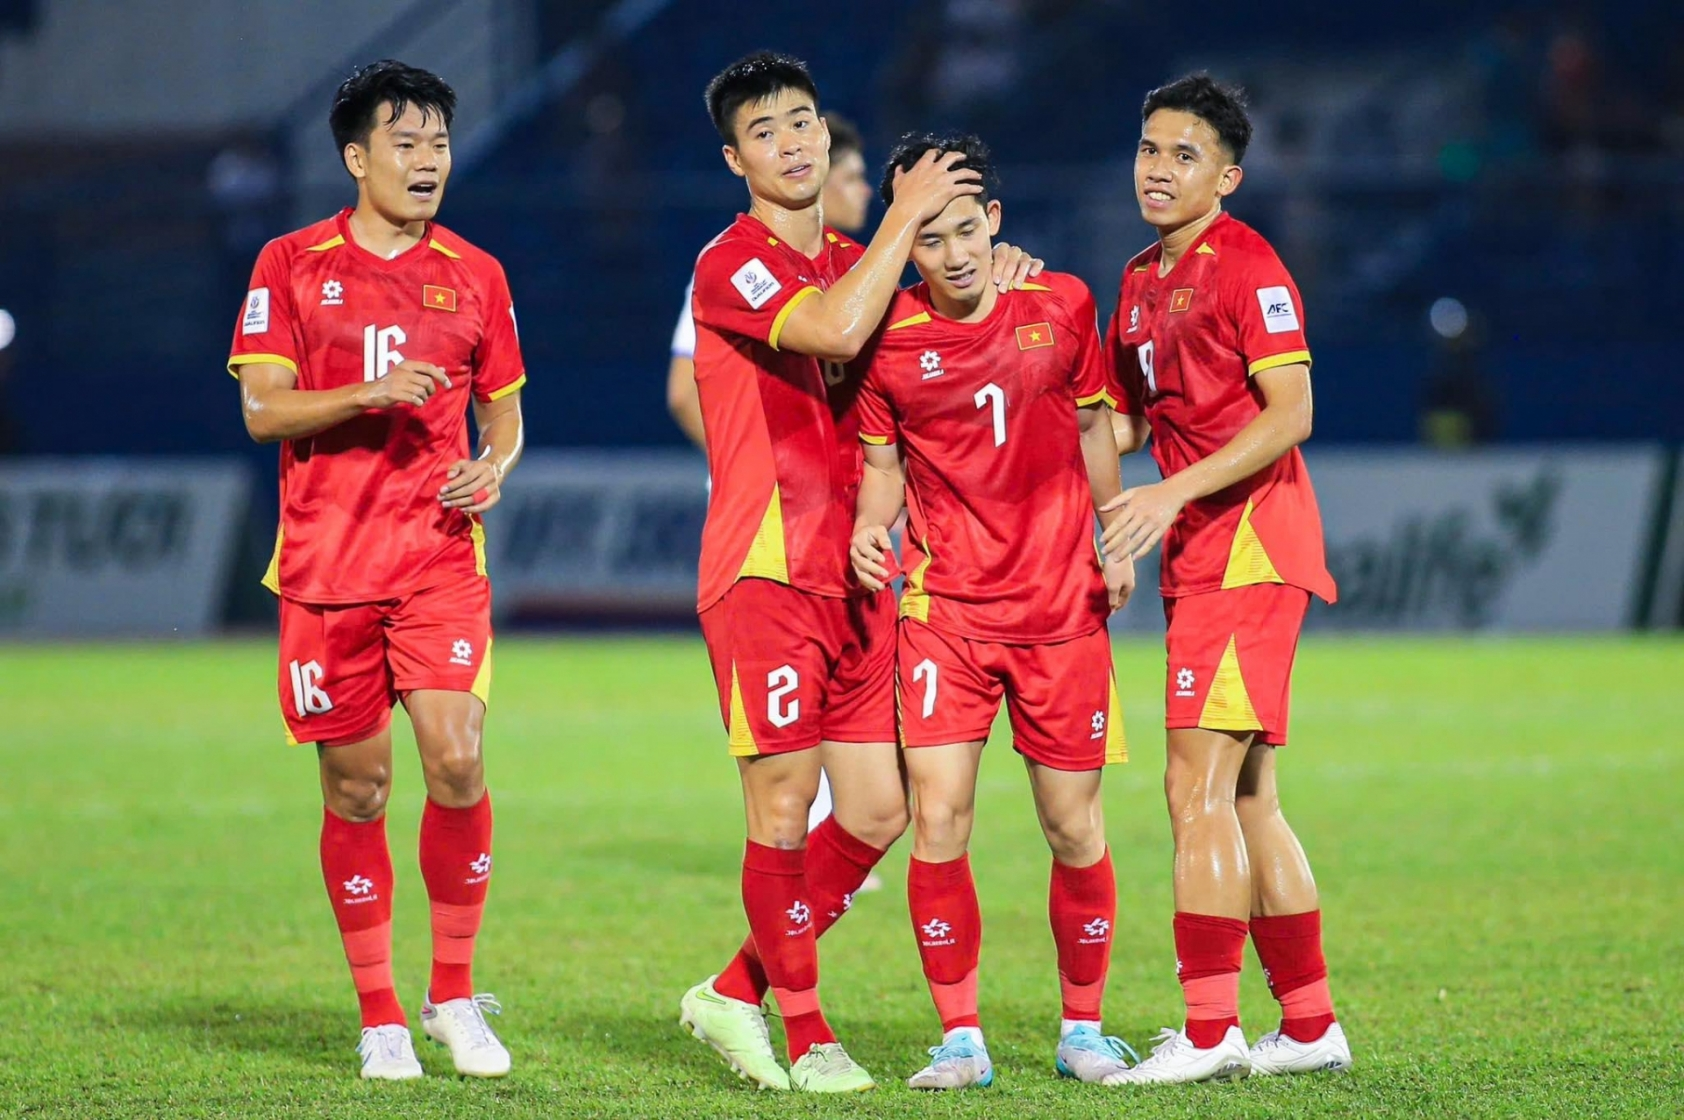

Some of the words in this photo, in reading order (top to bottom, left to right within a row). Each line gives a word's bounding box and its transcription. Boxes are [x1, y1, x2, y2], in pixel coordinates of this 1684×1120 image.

[1267, 302, 1289, 315] AFC
[364, 323, 407, 383] 16
[973, 382, 1007, 448] 7
[289, 659, 334, 718] 16
[767, 664, 800, 729] 2
[912, 658, 938, 720] 7
